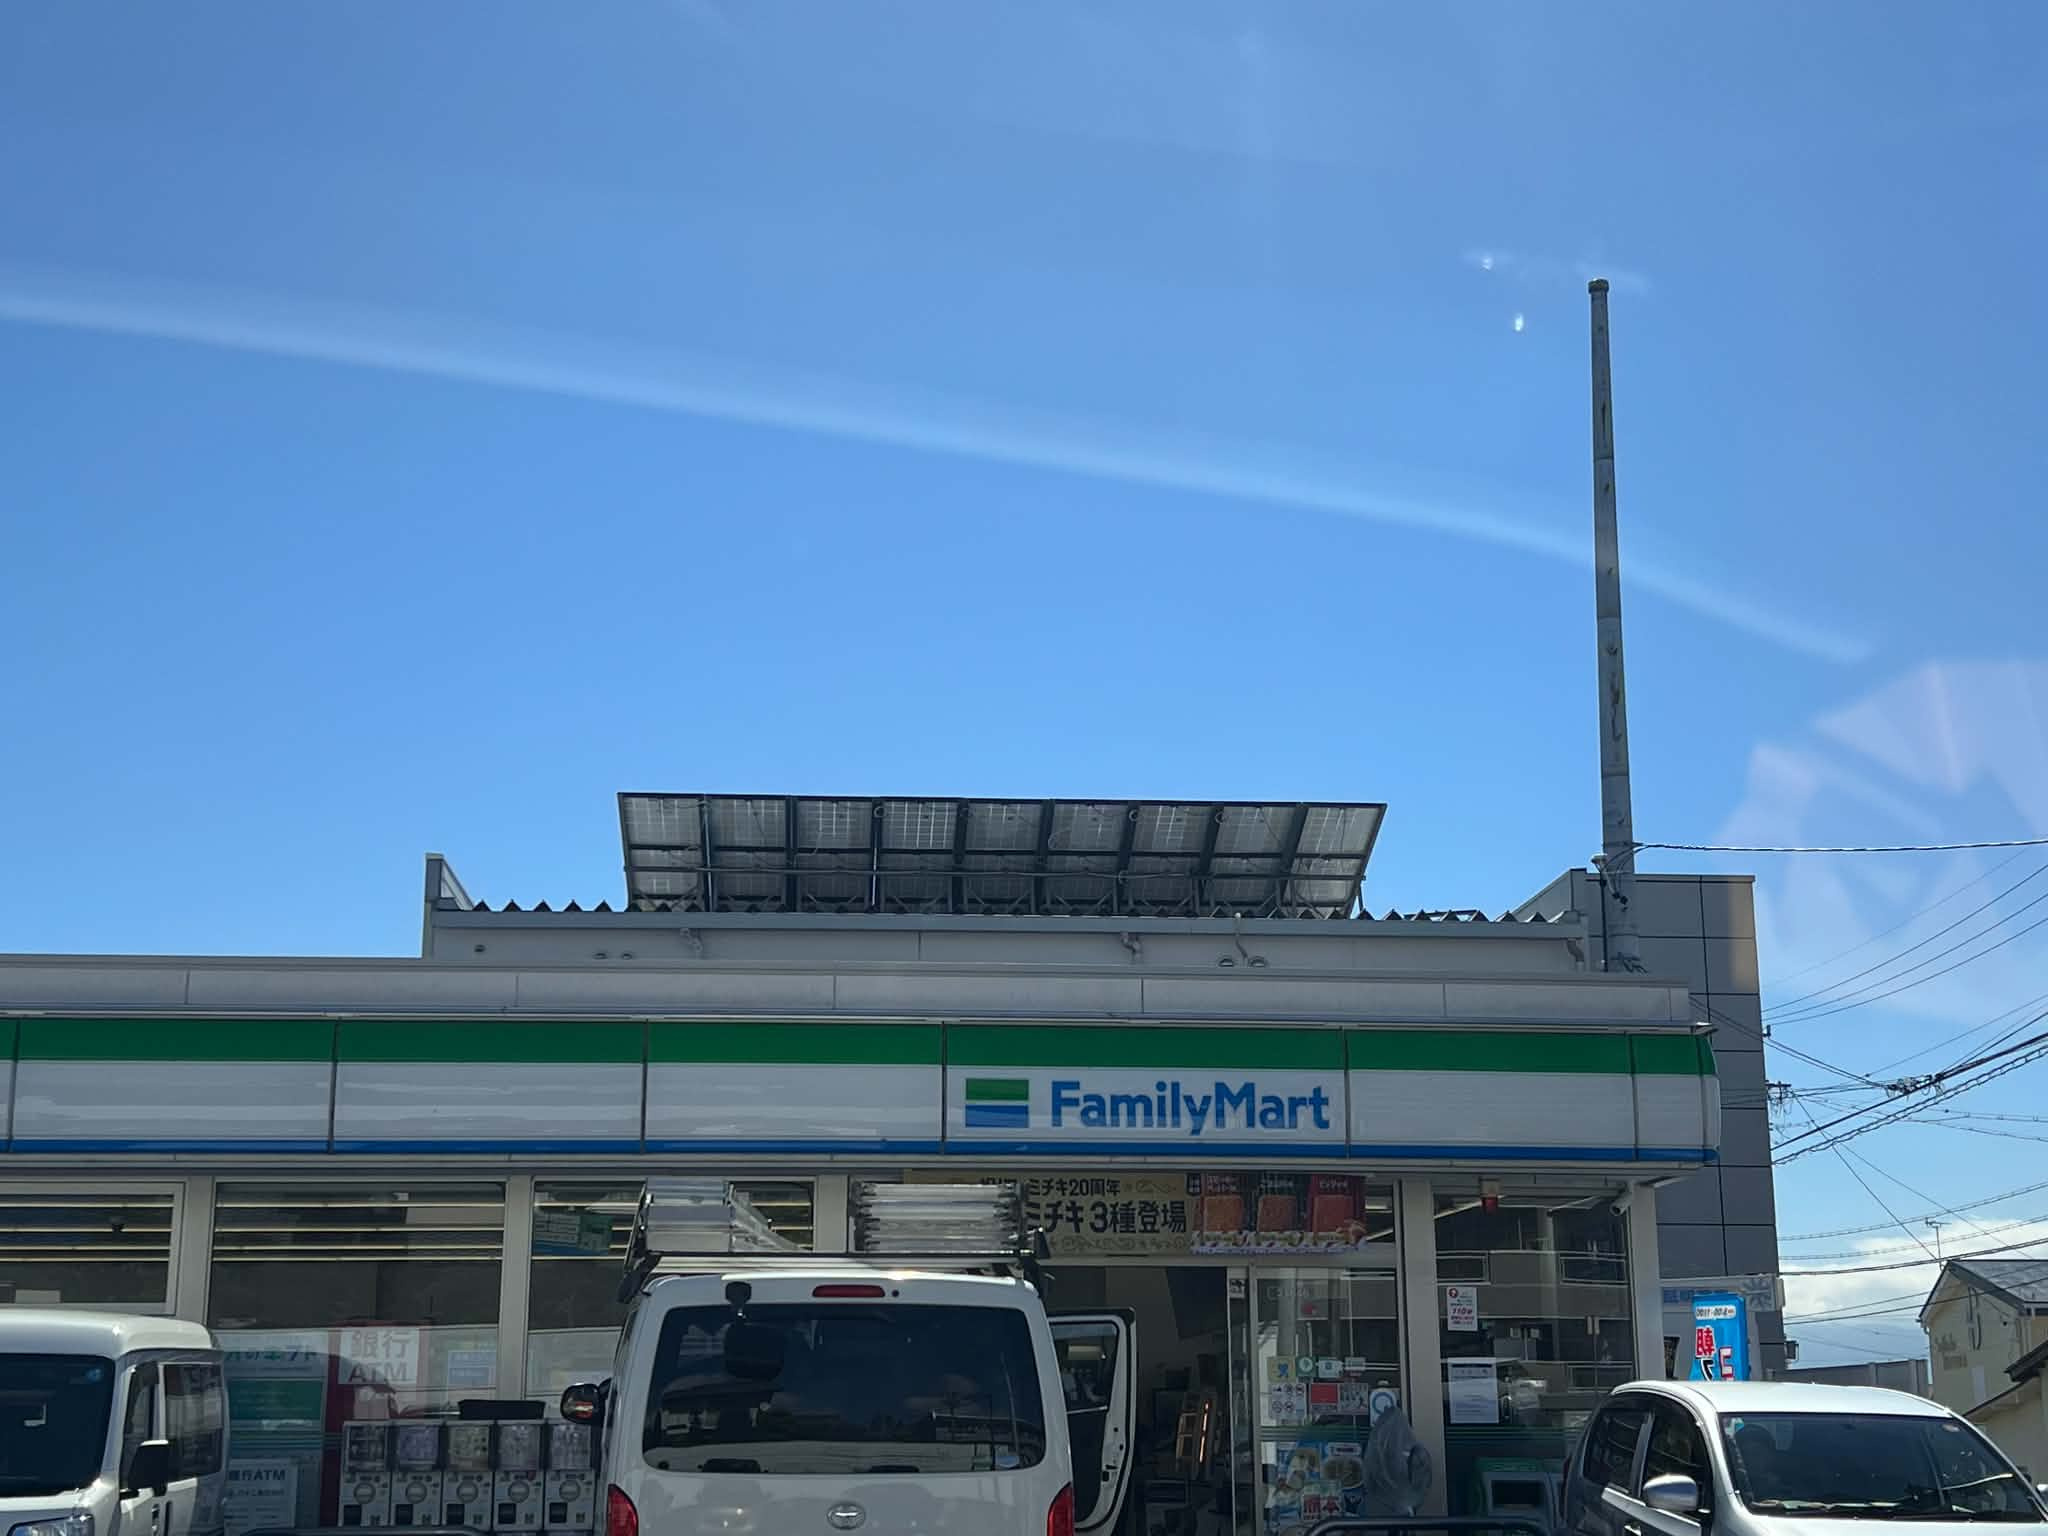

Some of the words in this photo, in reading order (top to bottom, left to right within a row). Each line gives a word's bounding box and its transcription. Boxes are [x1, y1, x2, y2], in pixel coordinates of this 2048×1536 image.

[1050, 1080, 1331, 1136] FamilyMart
[980, 1178, 1121, 1197] ミチキ20周年
[351, 1329, 410, 1361] 銀行
[347, 1361, 408, 1382] ATM
